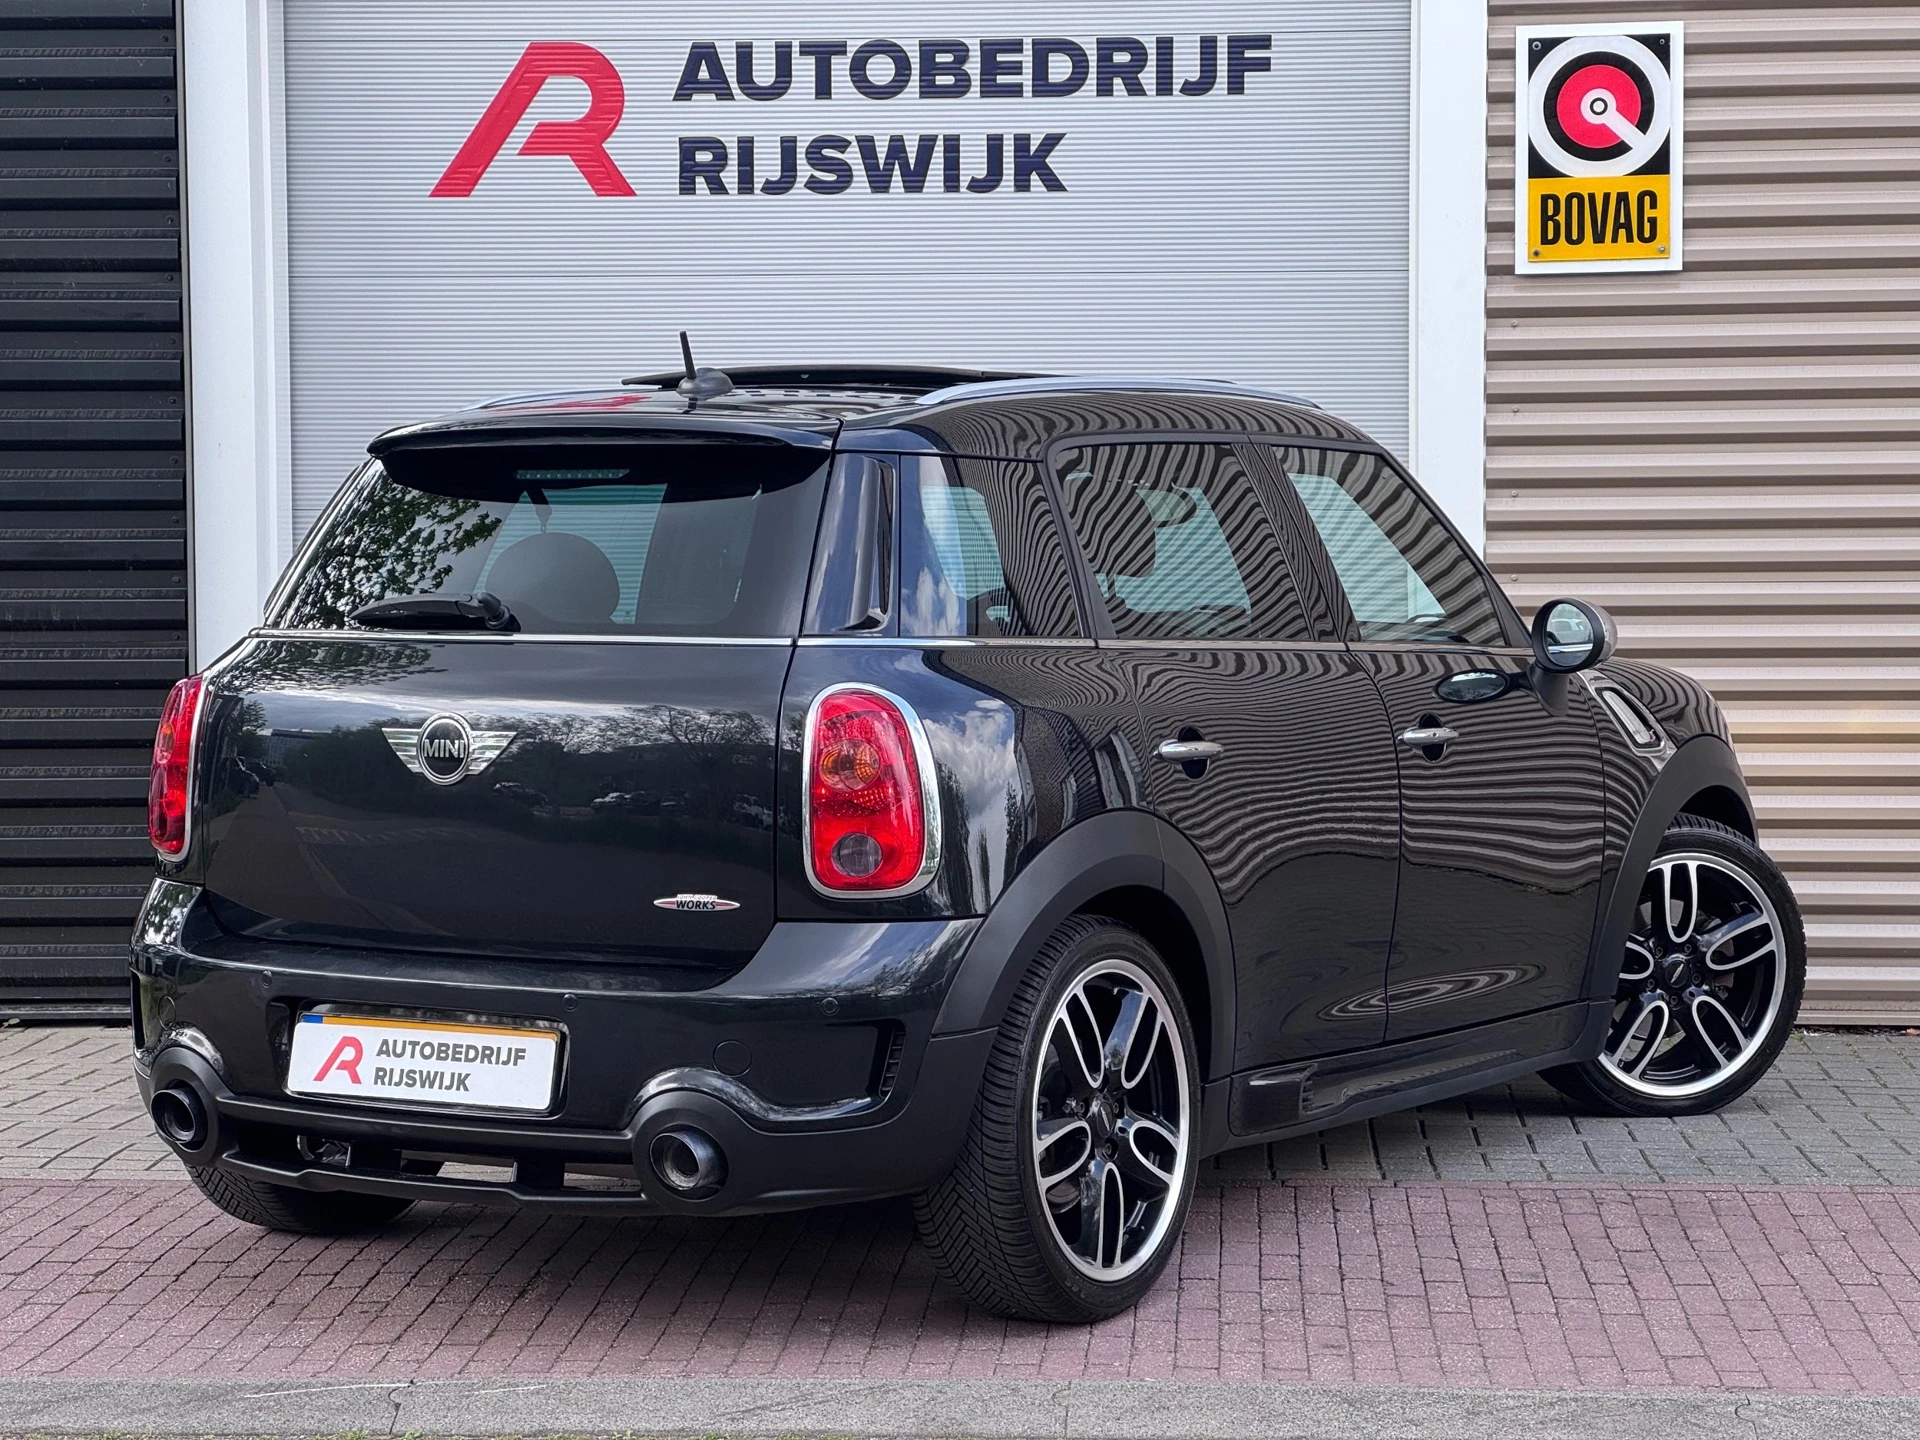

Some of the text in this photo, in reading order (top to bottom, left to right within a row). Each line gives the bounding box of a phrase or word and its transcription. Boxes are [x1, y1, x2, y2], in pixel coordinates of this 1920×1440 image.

[672, 35, 1273, 101] AUTOBEDRIJF
[678, 133, 1067, 195] RIJSWIJK
[1540, 190, 1658, 246] BOVAG
[423, 739, 465, 758] MINI
[676, 900, 717, 910] WORKS
[376, 1039, 527, 1067] AUTOBEDRIJF
[373, 1067, 471, 1092] RIJSWIJK
